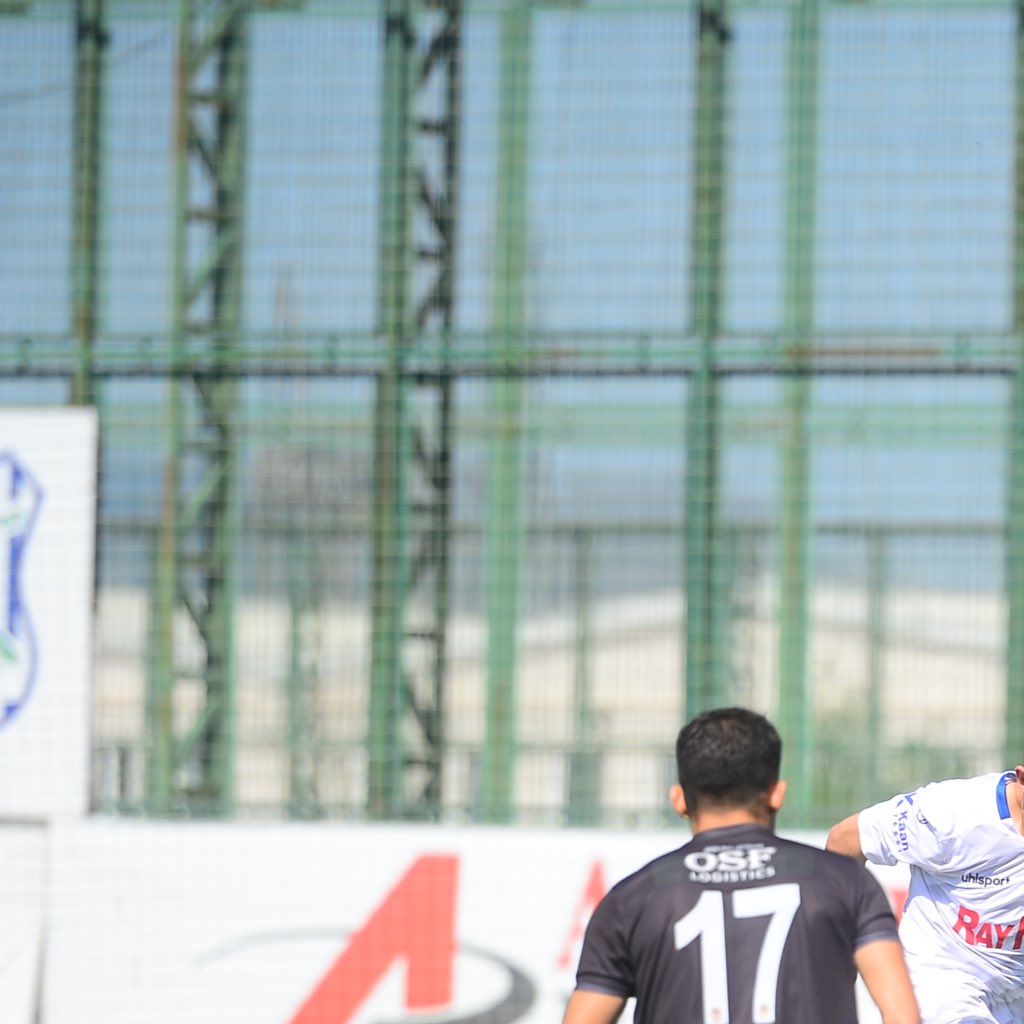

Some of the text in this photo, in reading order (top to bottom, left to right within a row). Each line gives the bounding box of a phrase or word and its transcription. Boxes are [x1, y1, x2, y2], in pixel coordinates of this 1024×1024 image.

[684, 847, 777, 873] OSF
[689, 866, 776, 884] LOGISTICS
[961, 872, 1010, 888] uhlsport
